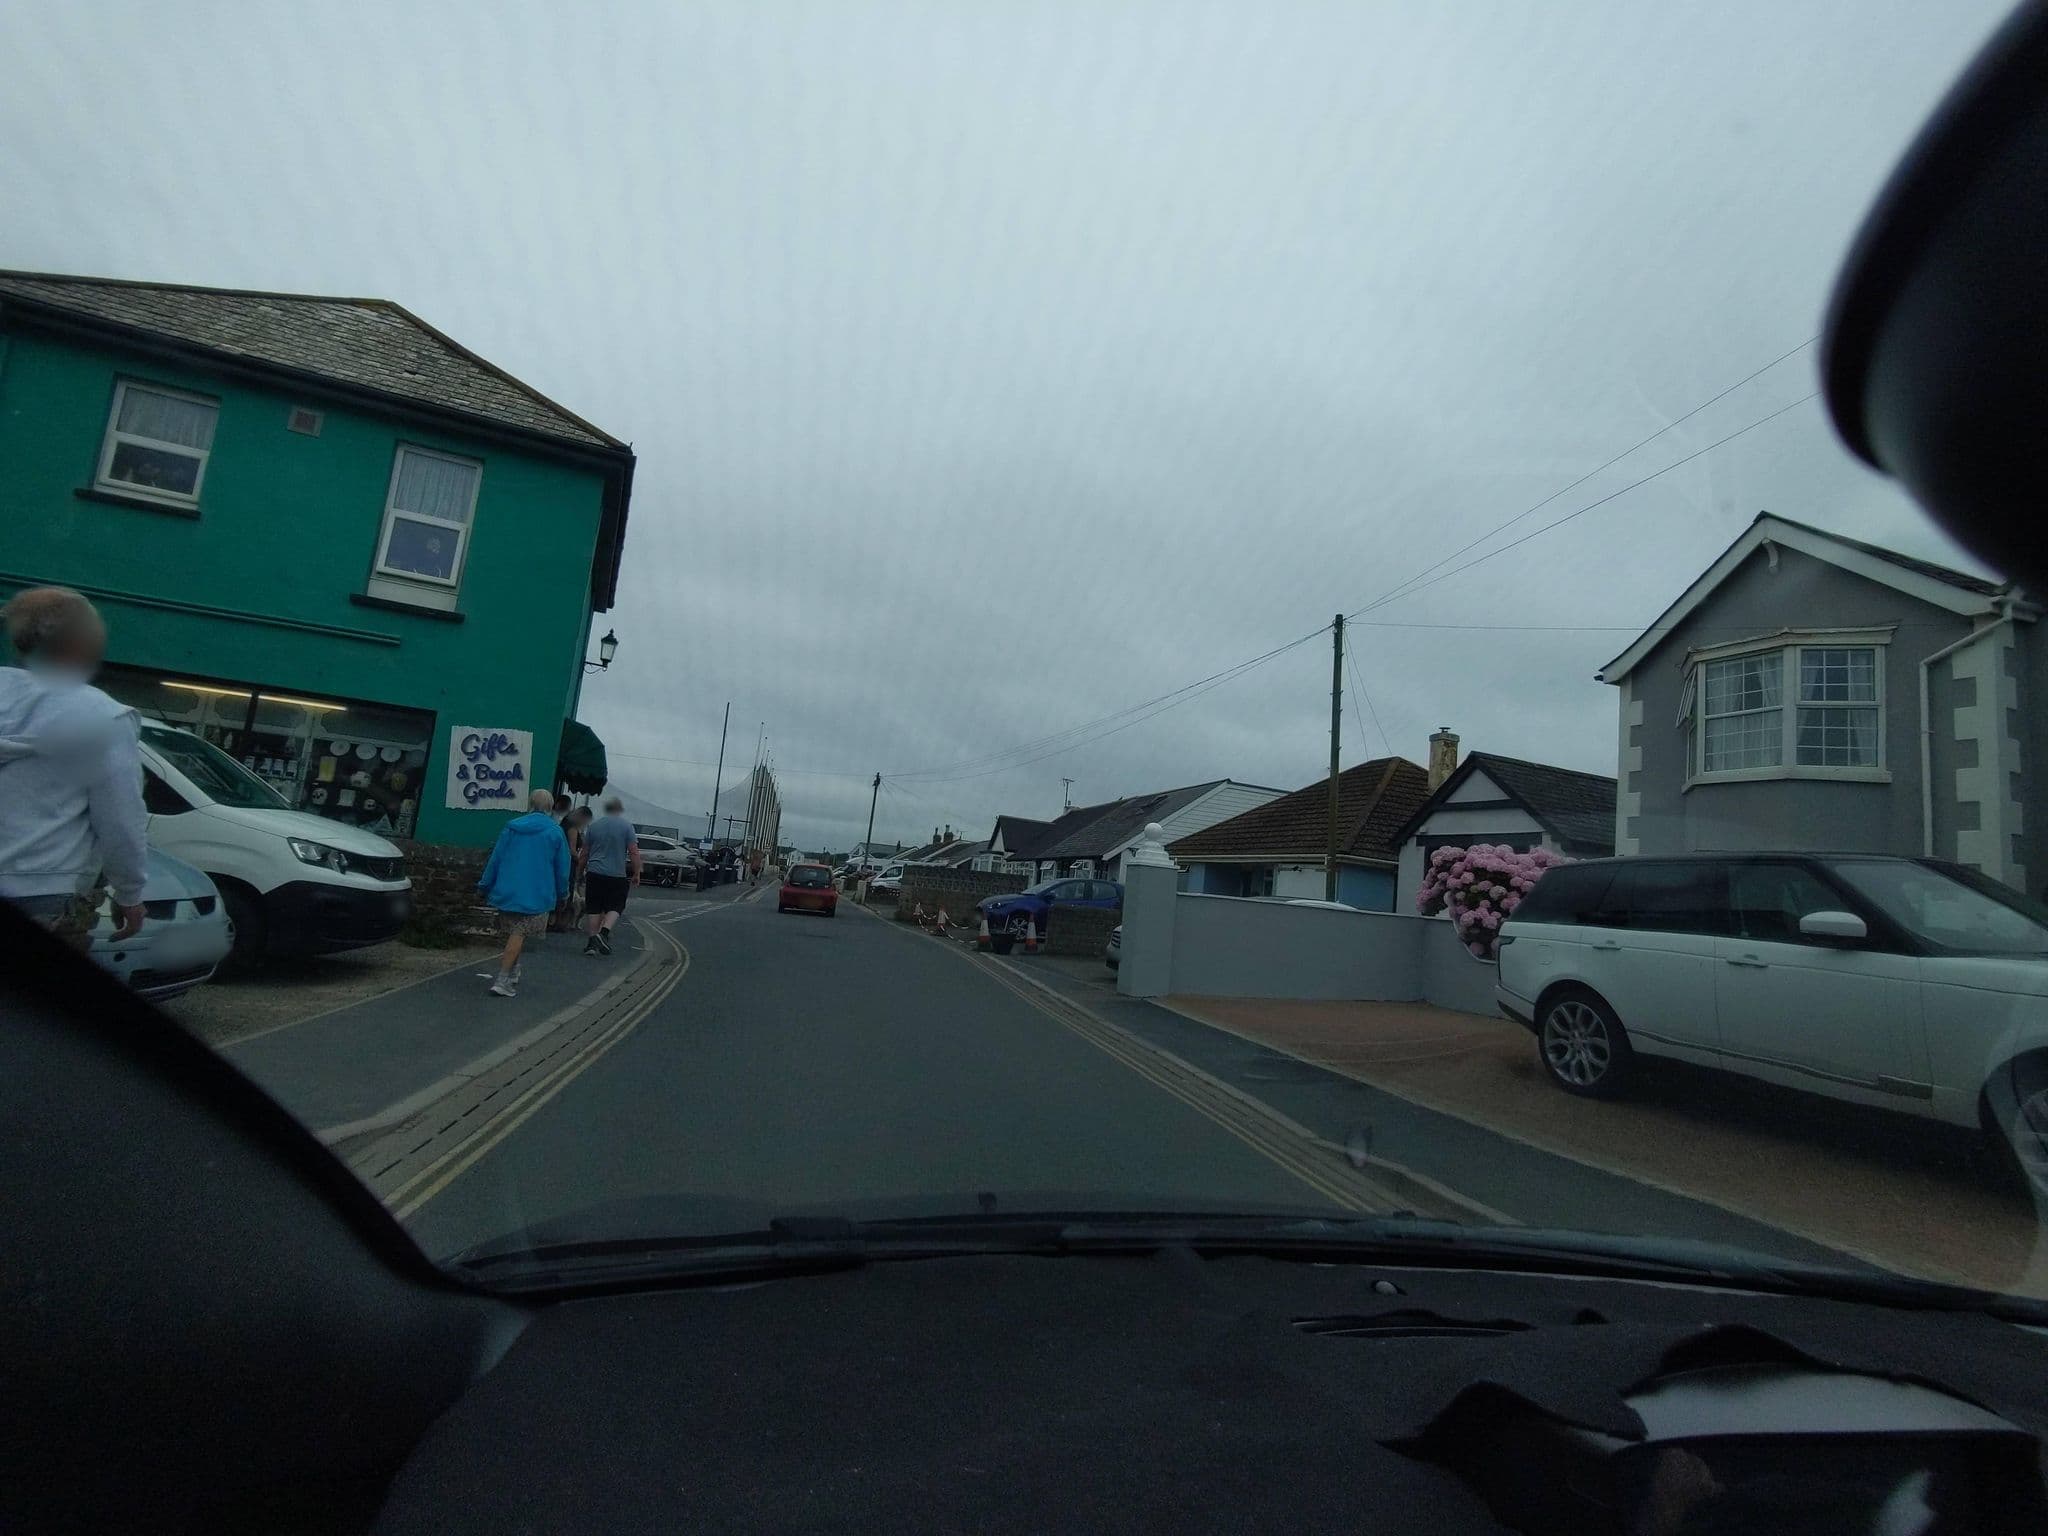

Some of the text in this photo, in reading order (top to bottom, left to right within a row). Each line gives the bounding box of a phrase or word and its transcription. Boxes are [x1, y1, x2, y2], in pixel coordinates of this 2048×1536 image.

[461, 733, 518, 762] Gifts
[456, 763, 523, 780] & Beach
[463, 780, 515, 804] Goods
